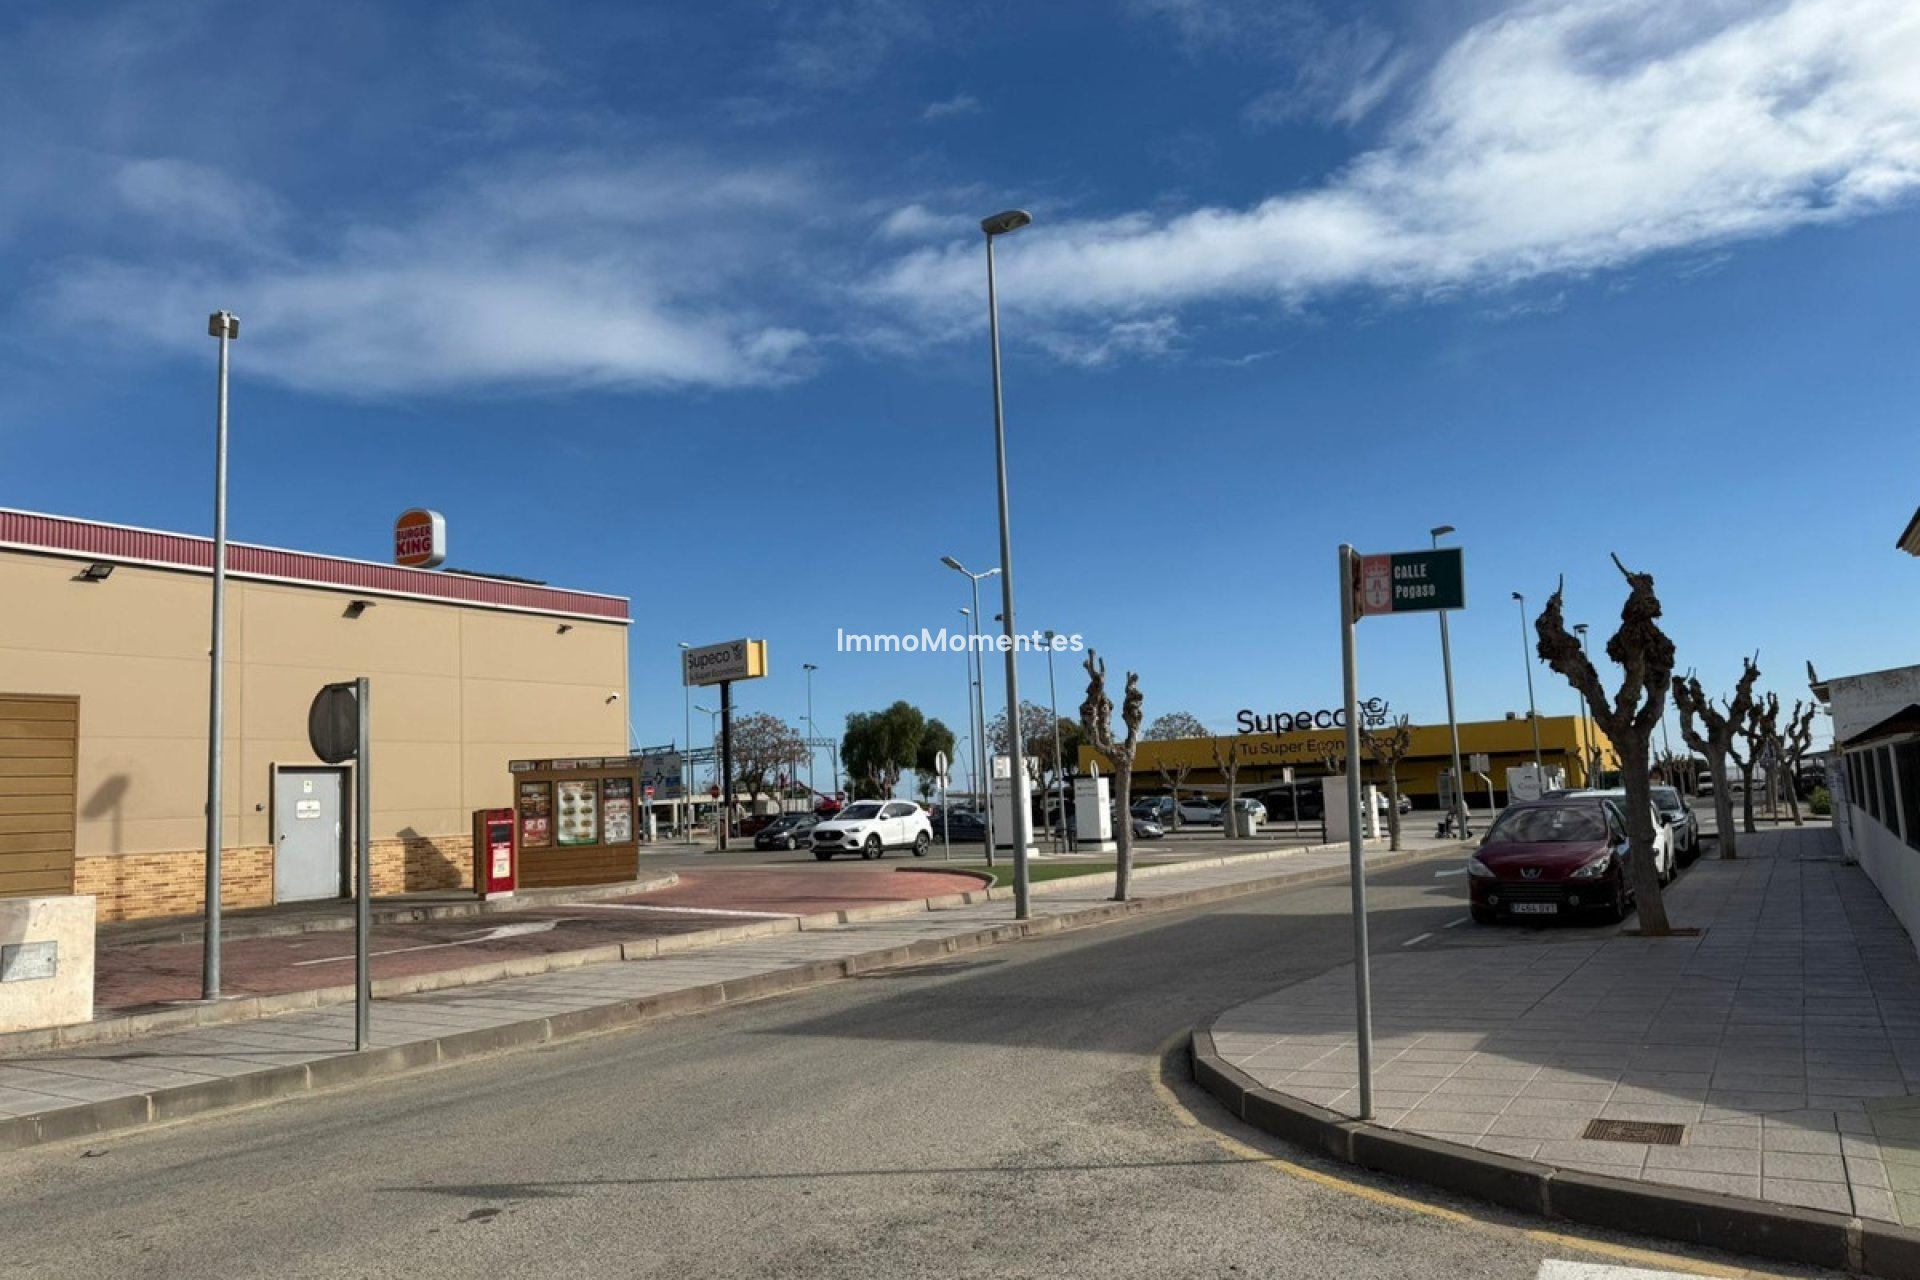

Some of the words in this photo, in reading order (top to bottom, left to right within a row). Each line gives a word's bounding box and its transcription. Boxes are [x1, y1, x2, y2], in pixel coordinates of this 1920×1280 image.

[396, 538, 431, 556] KING
[1394, 563, 1427, 579] CALLE
[1395, 583, 1436, 599] Pegaso
[1237, 708, 1346, 737] Supeco
[1240, 743, 1257, 756] Tu
[1258, 740, 1304, 756] Super
